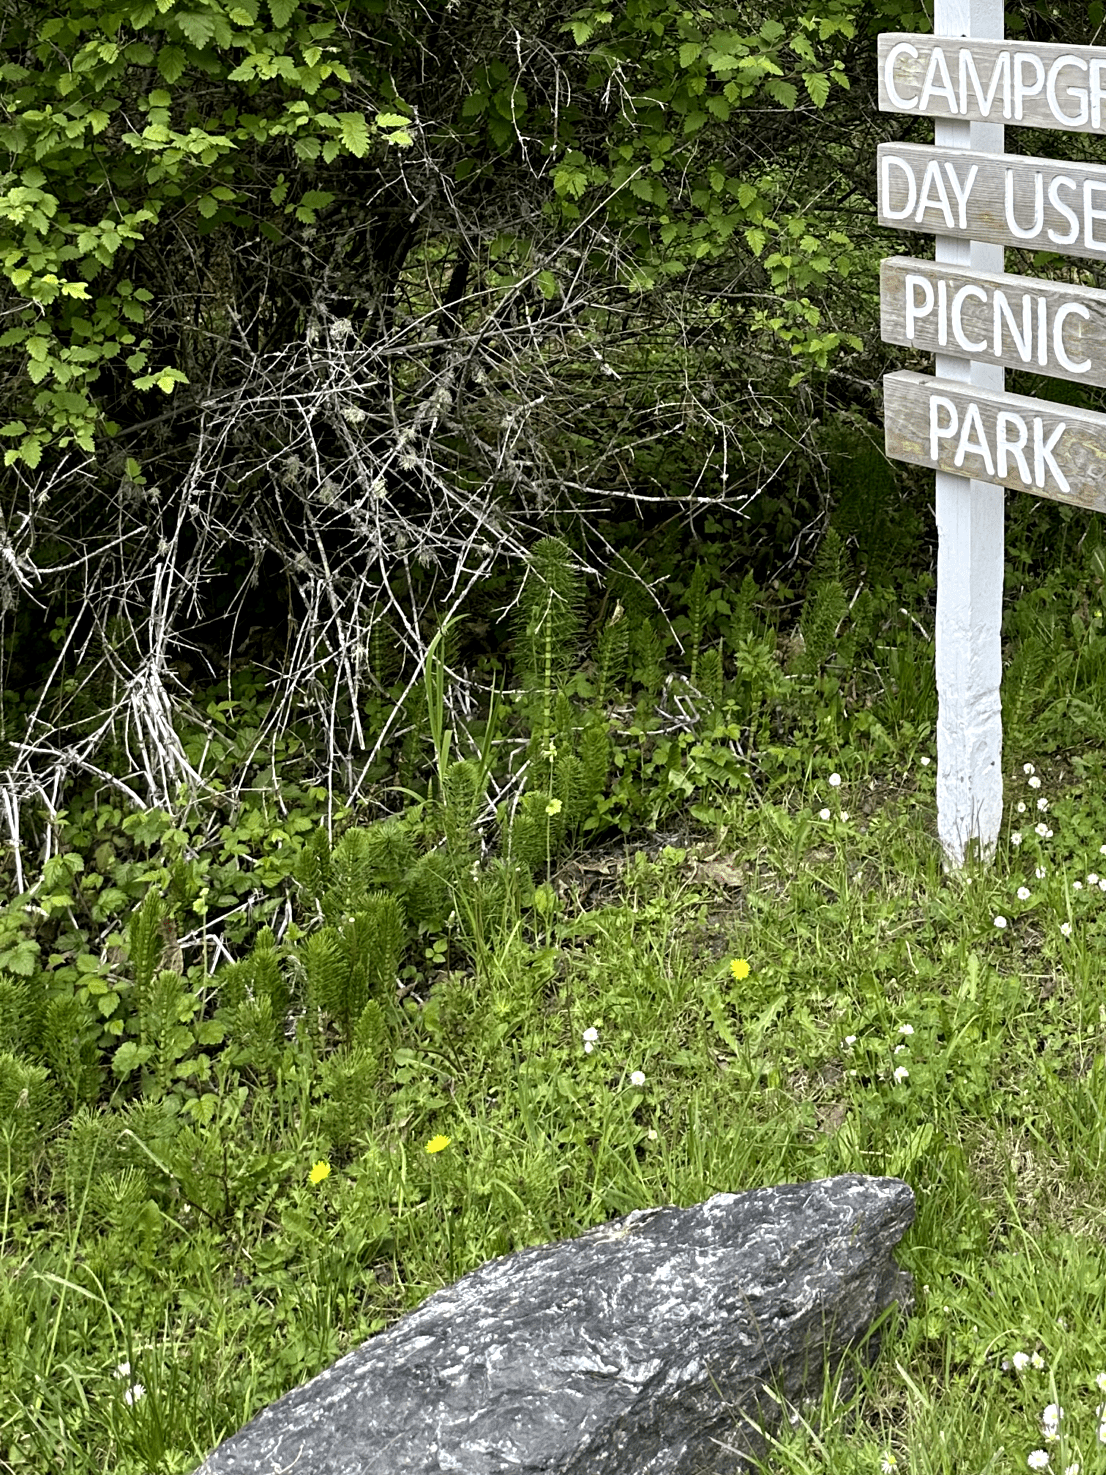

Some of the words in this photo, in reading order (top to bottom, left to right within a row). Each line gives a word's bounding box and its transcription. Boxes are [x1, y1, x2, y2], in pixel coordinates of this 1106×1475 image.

[881, 155, 979, 230] DAY
[904, 274, 1092, 373] PICNIC
[928, 395, 1070, 493] PARK
